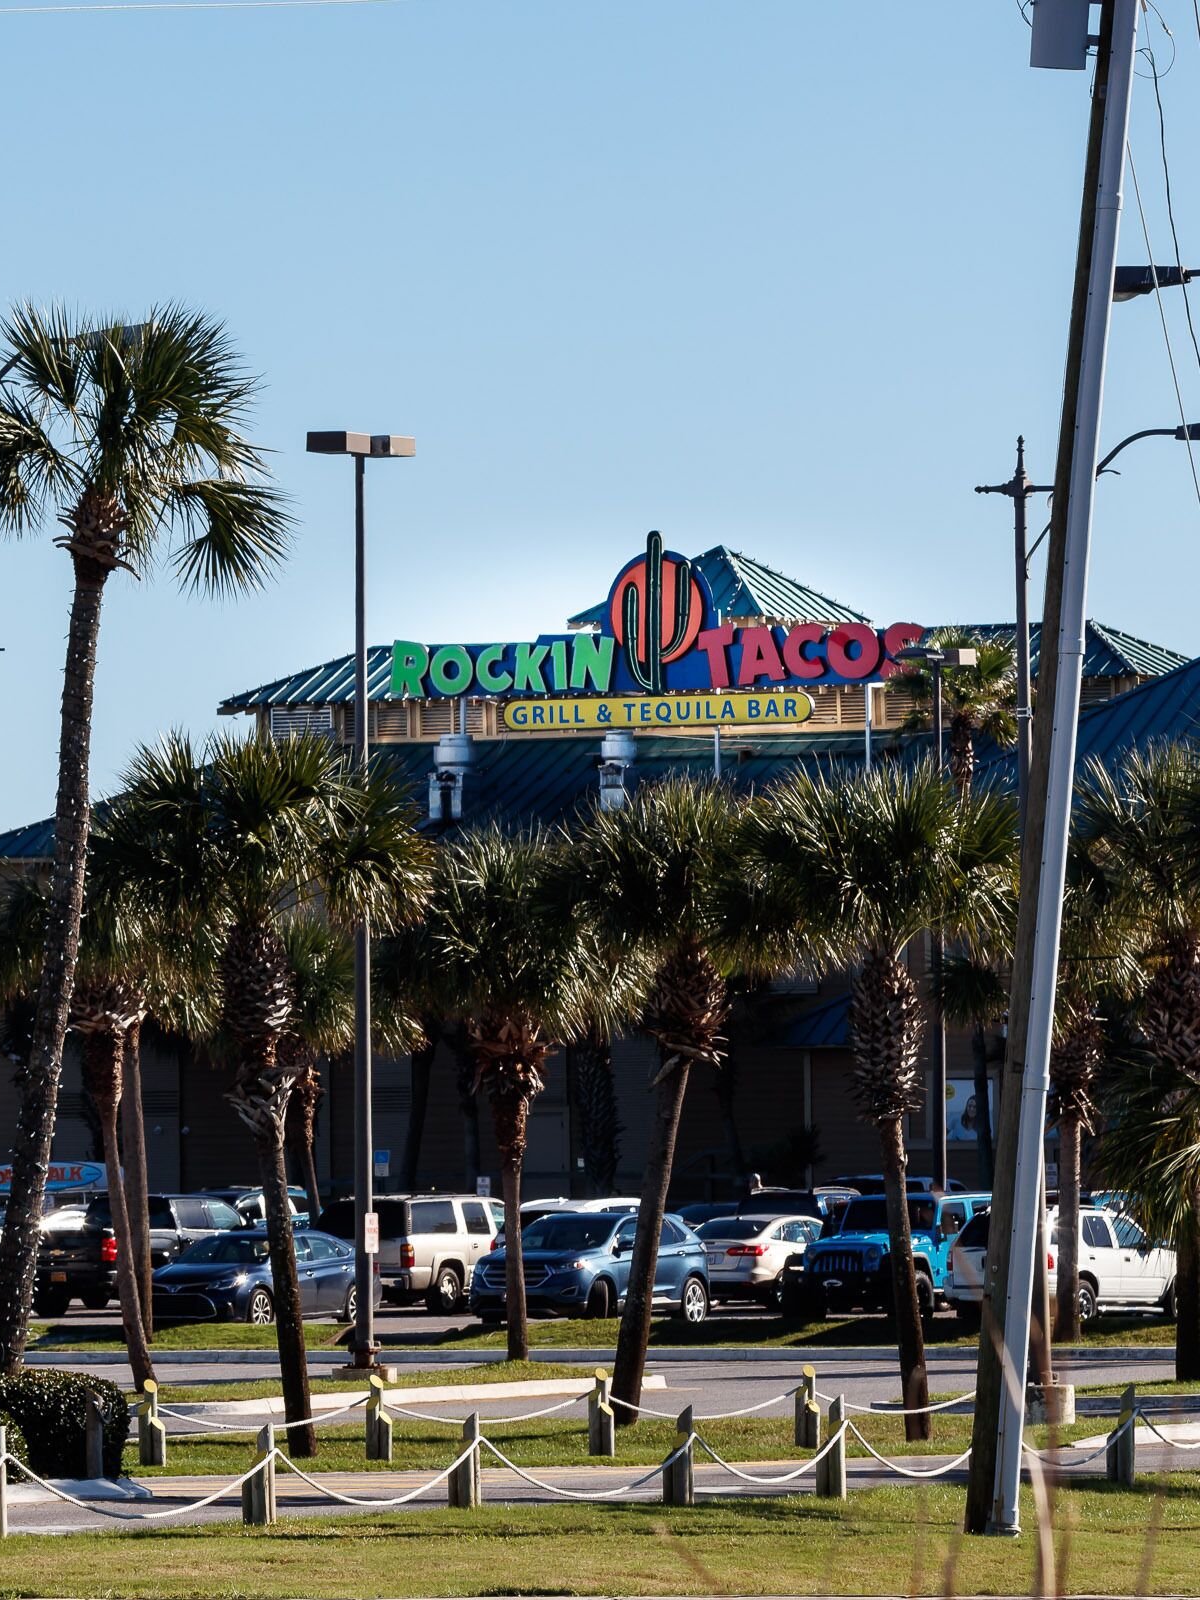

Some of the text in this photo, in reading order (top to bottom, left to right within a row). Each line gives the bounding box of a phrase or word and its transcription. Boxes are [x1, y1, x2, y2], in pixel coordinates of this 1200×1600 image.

[390, 622, 926, 698] ROCKIN TACOS
[512, 697, 798, 726] GRILL & TEQUILA BAR
